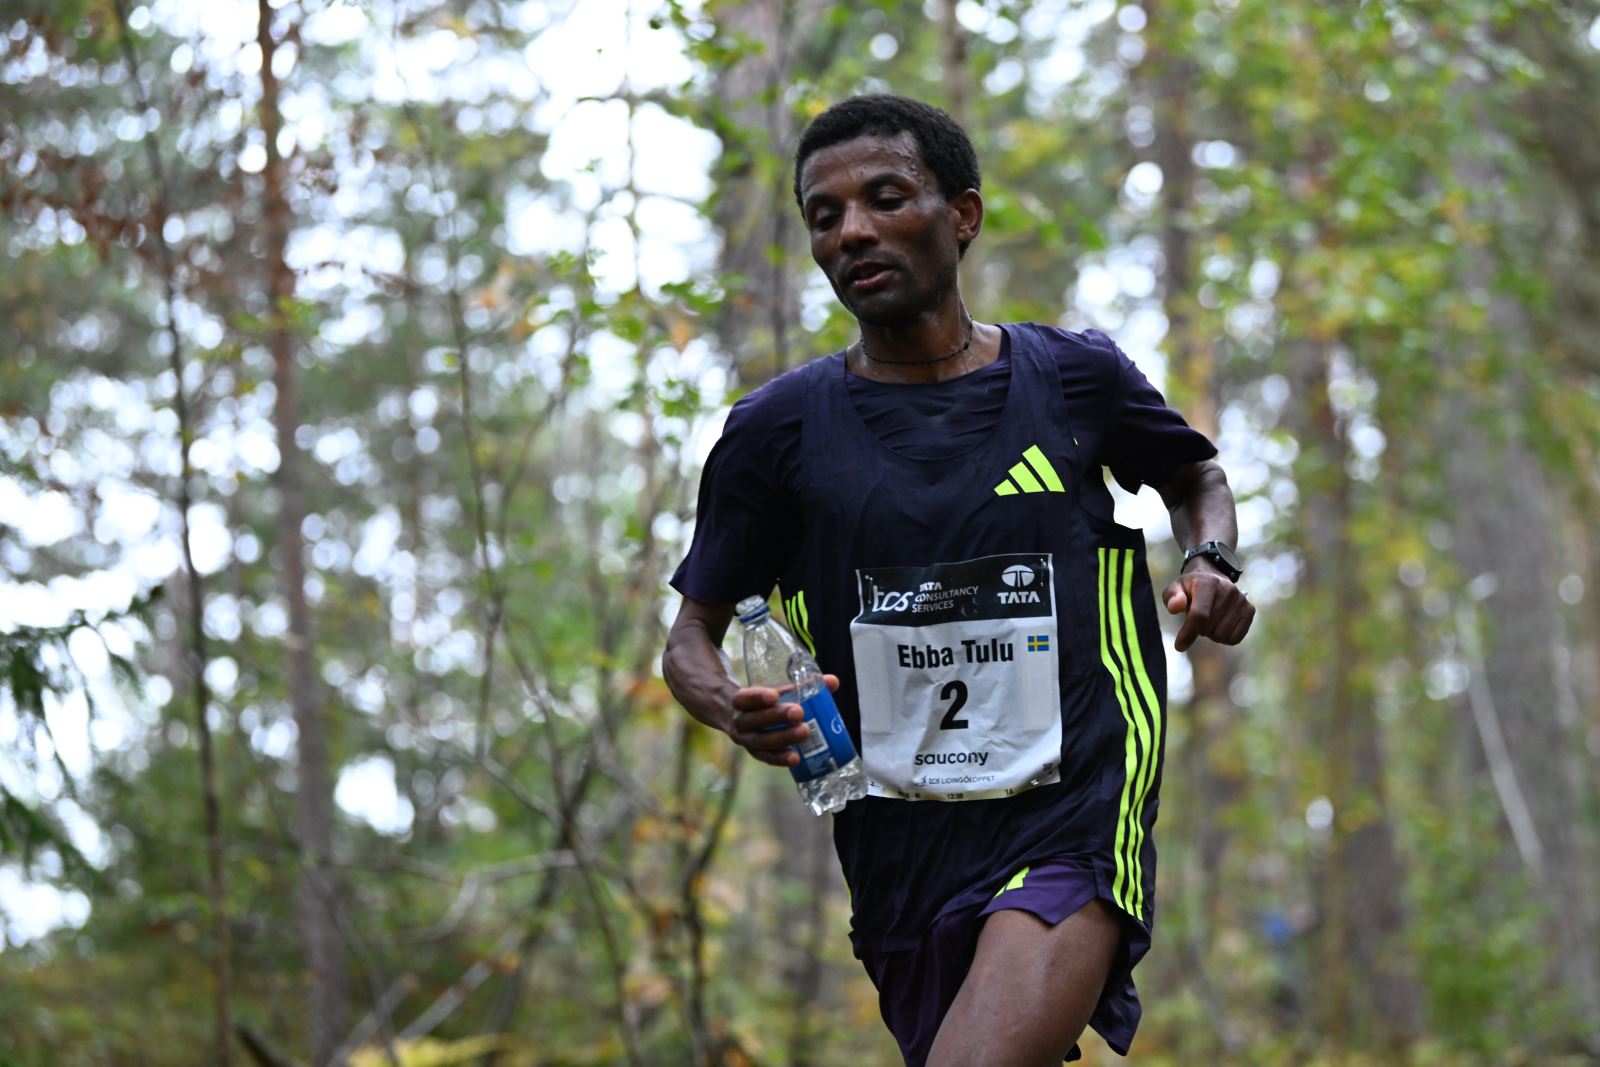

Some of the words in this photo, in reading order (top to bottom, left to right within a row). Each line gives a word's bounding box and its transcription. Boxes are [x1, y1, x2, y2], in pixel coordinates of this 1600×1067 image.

[872, 585, 914, 612] tcs
[914, 585, 979, 602] CONSULTANCY
[997, 591, 1040, 604] TATA
[911, 600, 954, 613] SERVICES
[897, 644, 954, 669] Ebba
[961, 638, 1014, 663] Tulu
[940, 680, 969, 730] 2
[914, 751, 989, 766] saucony
